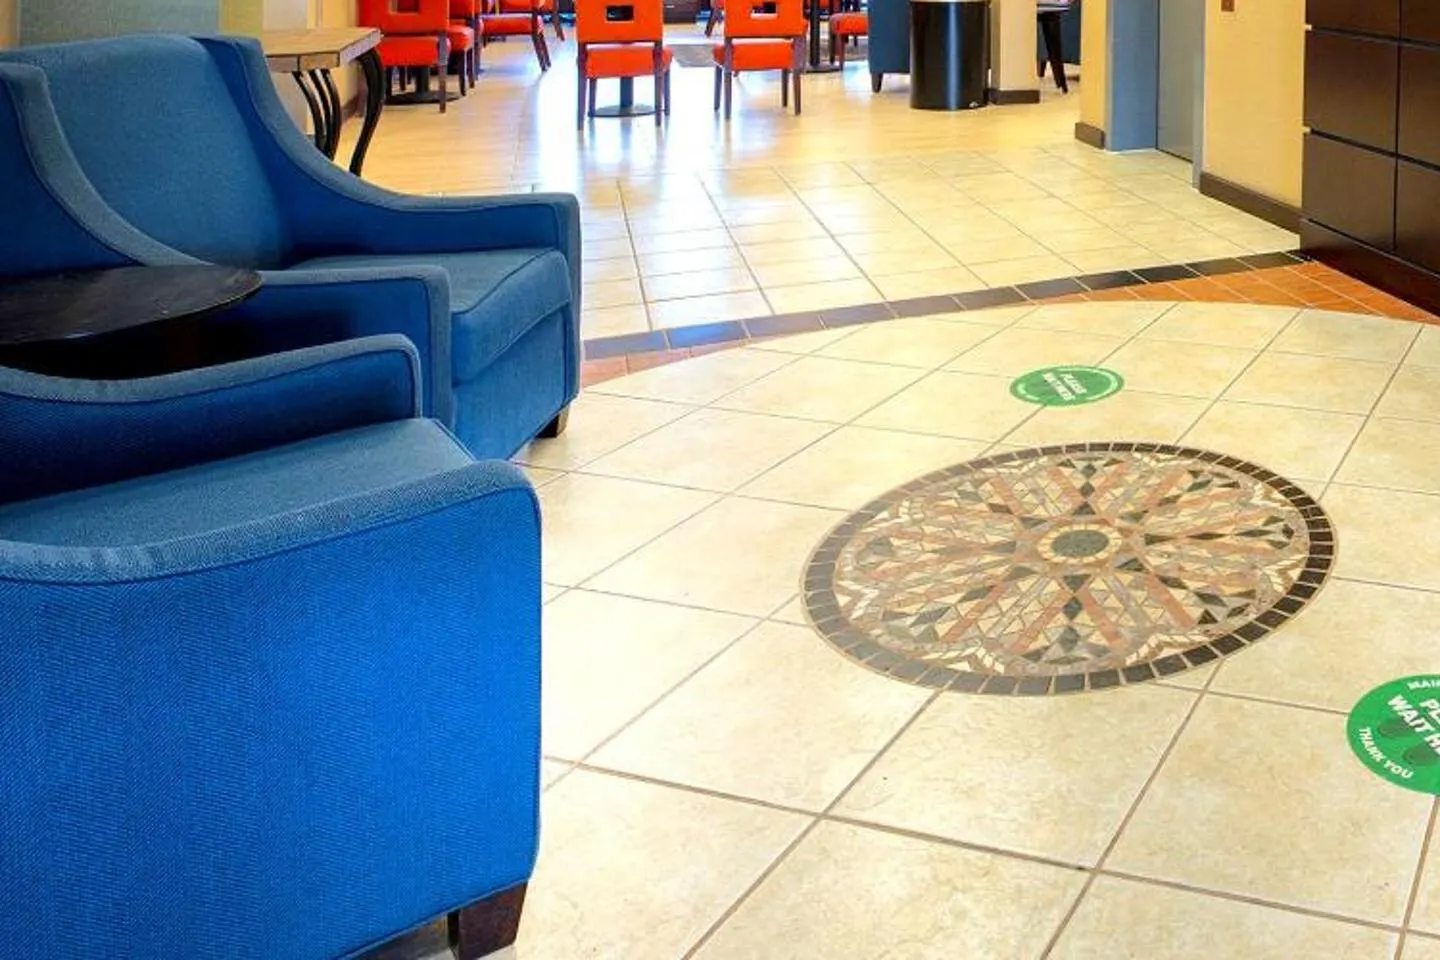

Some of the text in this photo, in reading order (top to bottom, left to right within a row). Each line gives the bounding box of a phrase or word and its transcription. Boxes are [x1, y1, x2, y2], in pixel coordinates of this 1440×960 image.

[1386, 694, 1434, 733] WAIT
[1358, 726, 1414, 779] THANK YOU
